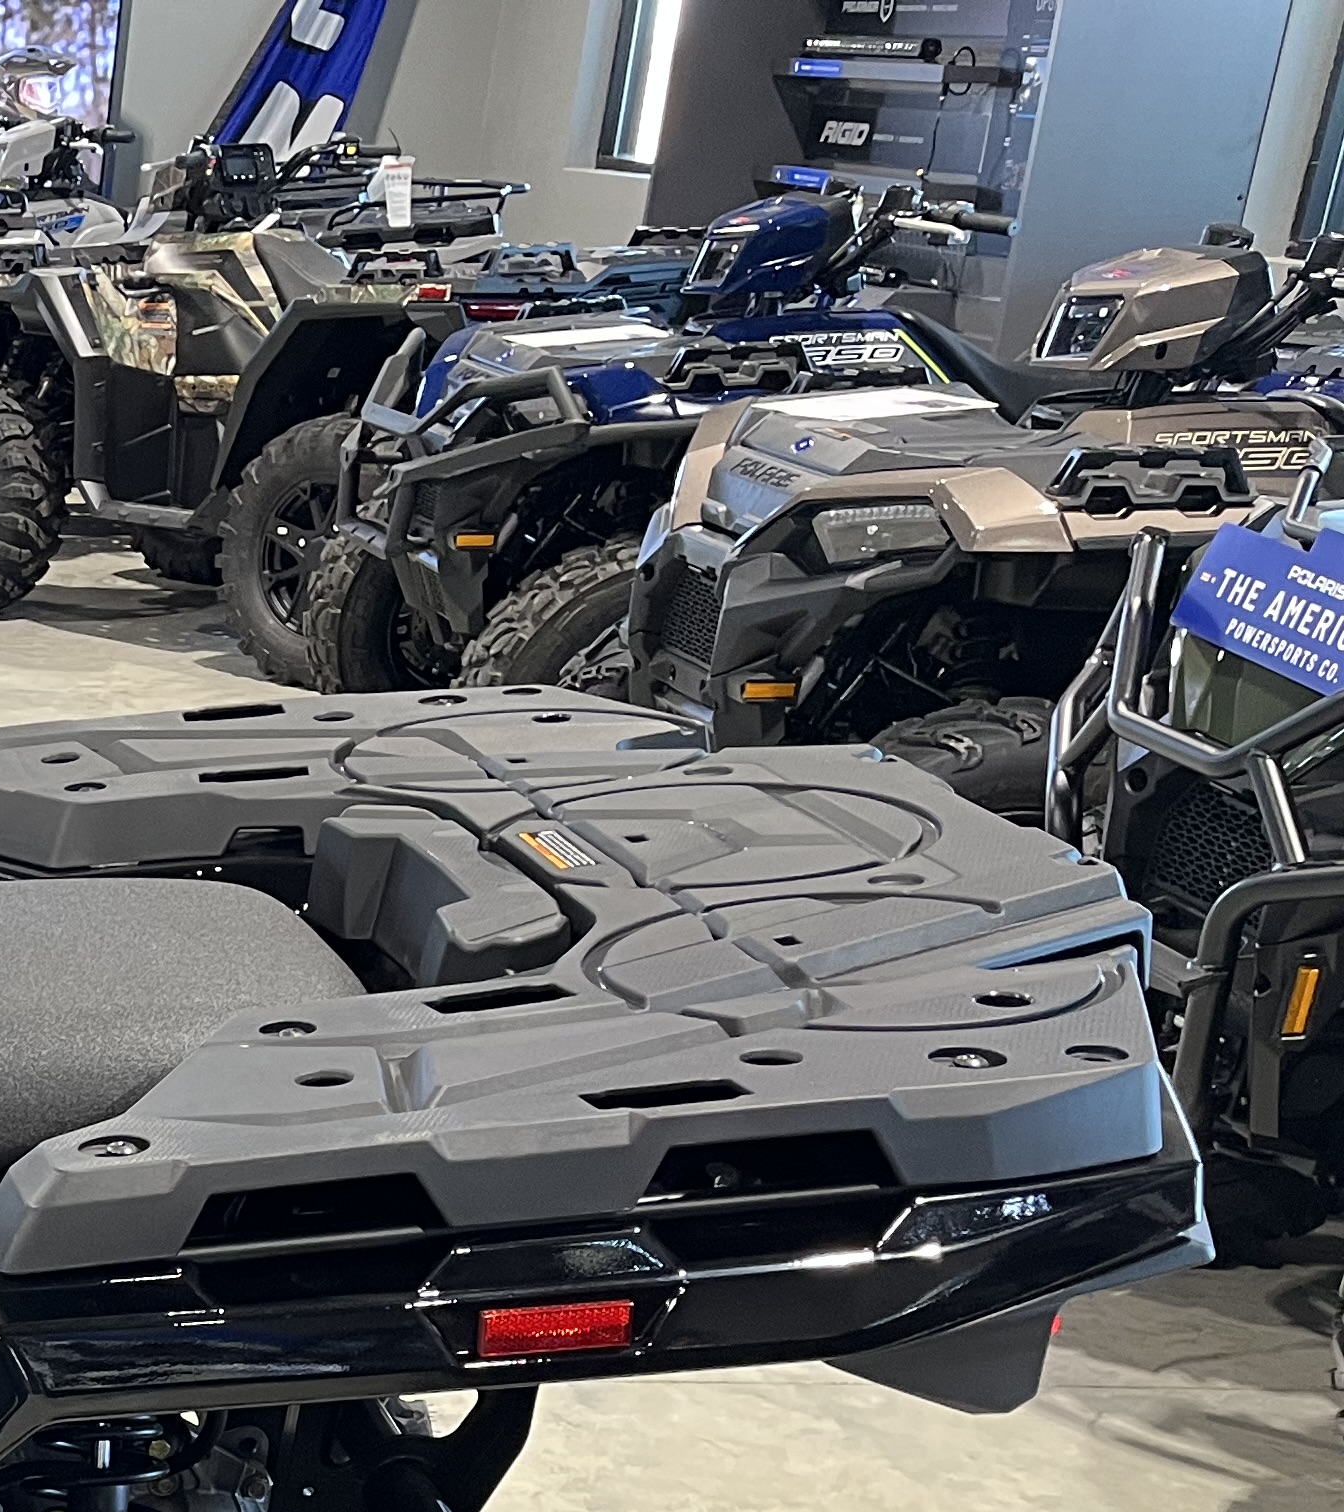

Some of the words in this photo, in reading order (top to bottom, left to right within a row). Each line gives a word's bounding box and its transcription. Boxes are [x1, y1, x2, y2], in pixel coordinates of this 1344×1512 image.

[820, 120, 870, 146] RIGID
[1216, 567, 1267, 612] THE
[1225, 618, 1319, 673] POWERSPORTS
[1317, 659, 1339, 684] CO.
